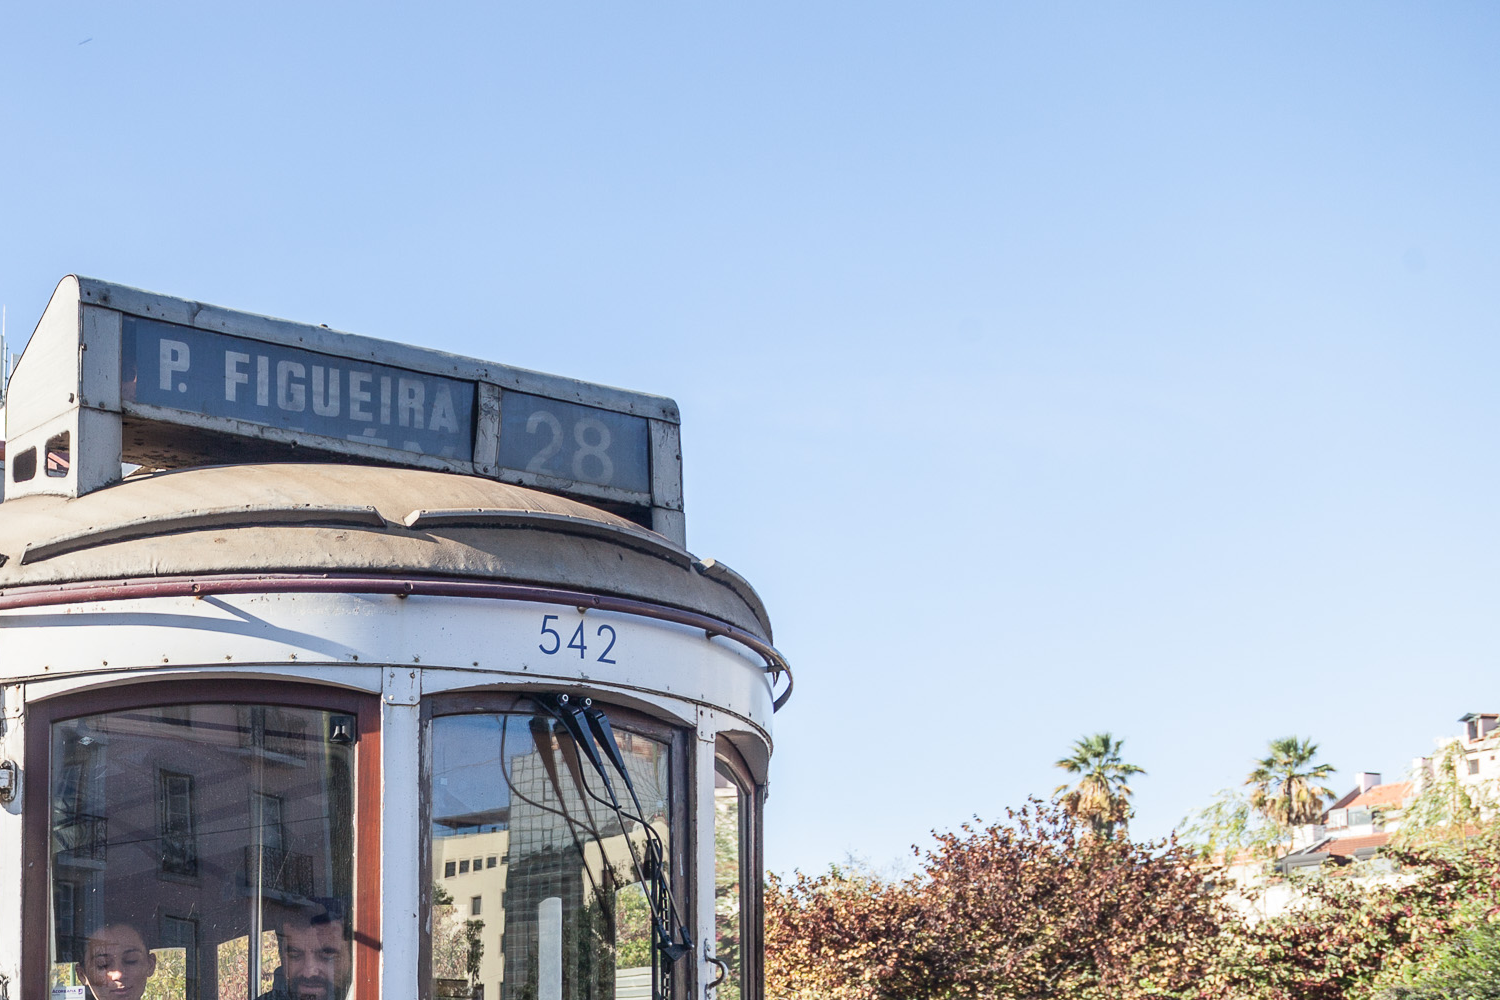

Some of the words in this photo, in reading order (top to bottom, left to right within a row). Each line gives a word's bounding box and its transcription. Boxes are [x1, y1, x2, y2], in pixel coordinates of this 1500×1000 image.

[158, 336, 191, 393] P.
[224, 349, 461, 434] FIGUEIRA
[525, 409, 615, 483] 28
[538, 613, 618, 665] 542
